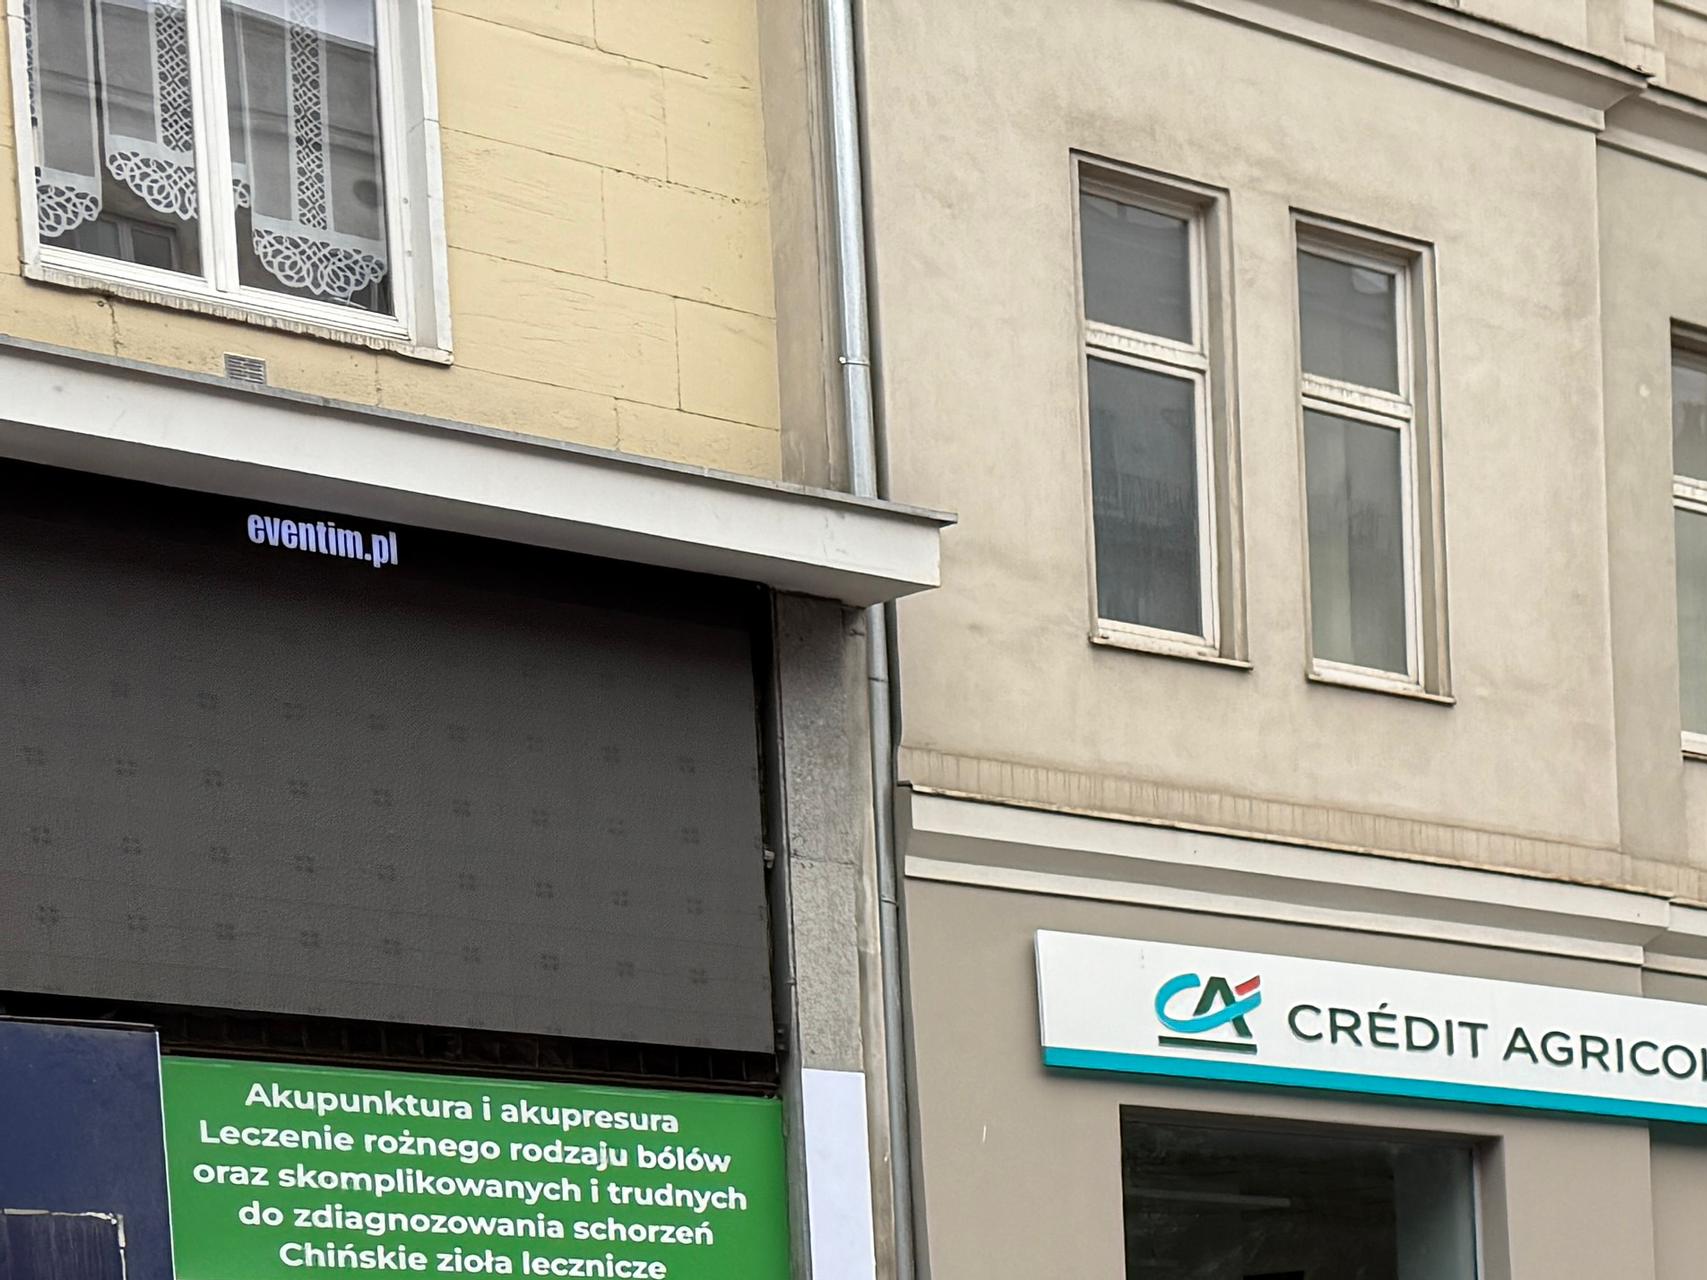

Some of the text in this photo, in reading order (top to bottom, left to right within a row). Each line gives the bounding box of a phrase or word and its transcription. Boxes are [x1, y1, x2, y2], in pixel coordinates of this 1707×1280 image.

[247, 514, 398, 568] eventim.pl
[1287, 1003, 1488, 1059] CRÉDIT
[245, 1083, 679, 1133] Akupunktura i akupresura
[200, 1120, 731, 1173] Leczenie rożnego rodzaju bólów
[193, 1163, 747, 1213] oraz skomplikowanych i trudnych
[238, 1200, 714, 1245] do zdiagnozowania schorzeń
[279, 1242, 667, 1280] Chińskie zioła lecznicze
